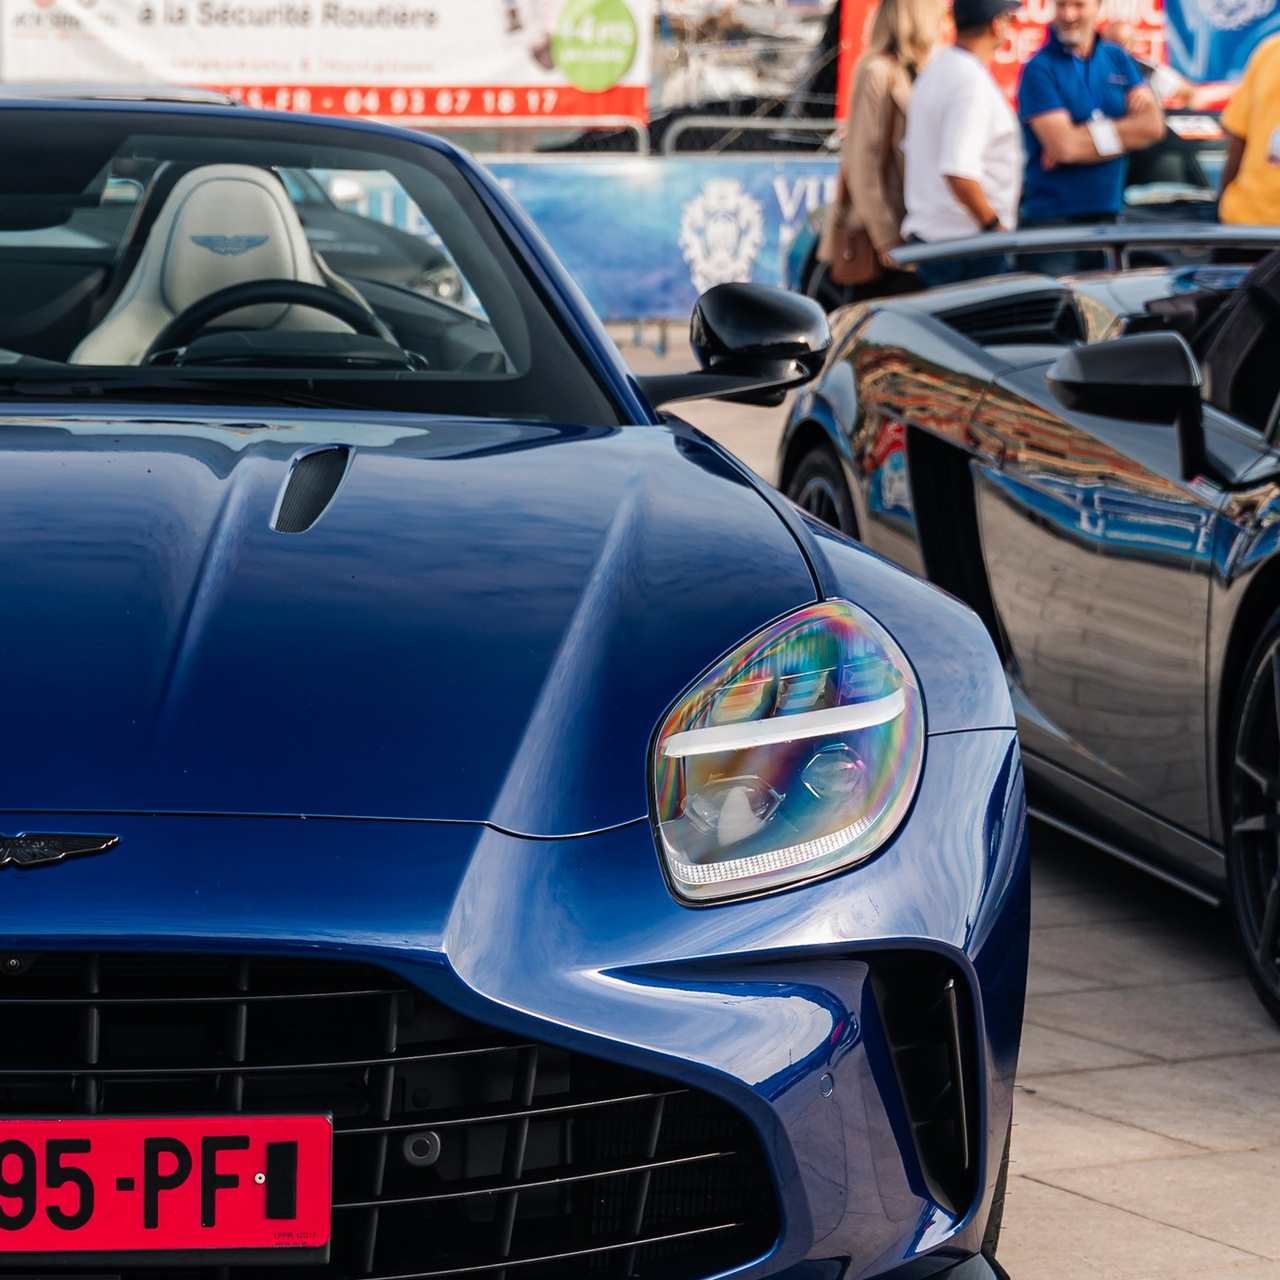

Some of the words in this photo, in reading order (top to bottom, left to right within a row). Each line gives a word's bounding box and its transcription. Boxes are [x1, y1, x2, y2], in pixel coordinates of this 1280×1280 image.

[162, 1, 189, 26] la
[198, 0, 314, 28] Sécurité
[322, 0, 440, 28] Routière
[343, 88, 380, 115] 04
[390, 88, 426, 114] 93
[482, 89, 516, 114] 18
[525, 89, 559, 114] 17
